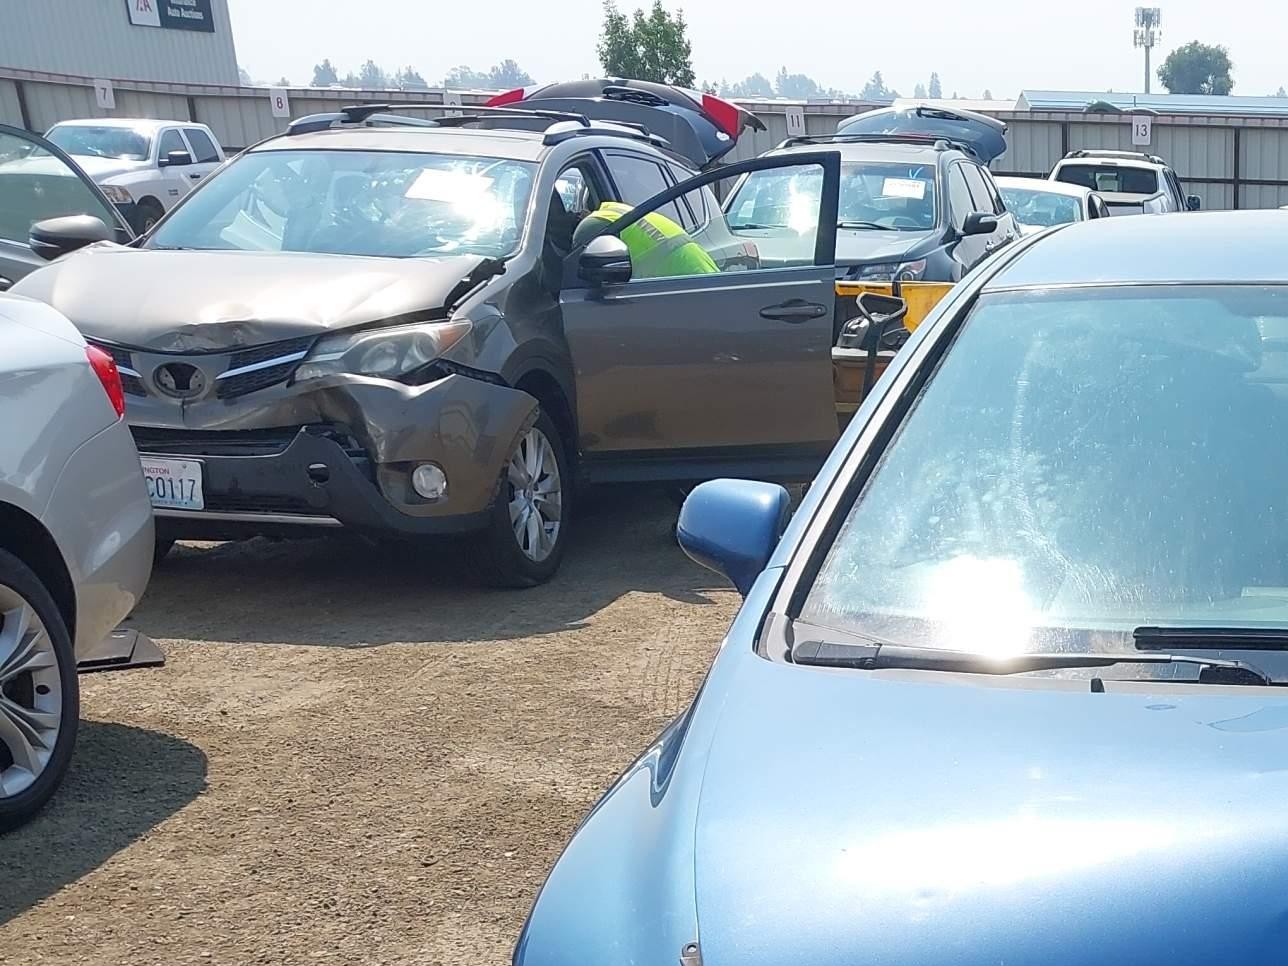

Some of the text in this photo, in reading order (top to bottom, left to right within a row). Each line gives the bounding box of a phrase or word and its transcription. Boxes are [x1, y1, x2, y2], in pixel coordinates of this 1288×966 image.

[101, 87, 107, 100] 7
[276, 97, 284, 109] 8
[790, 114, 801, 128] 11
[1135, 124, 1148, 137] 13
